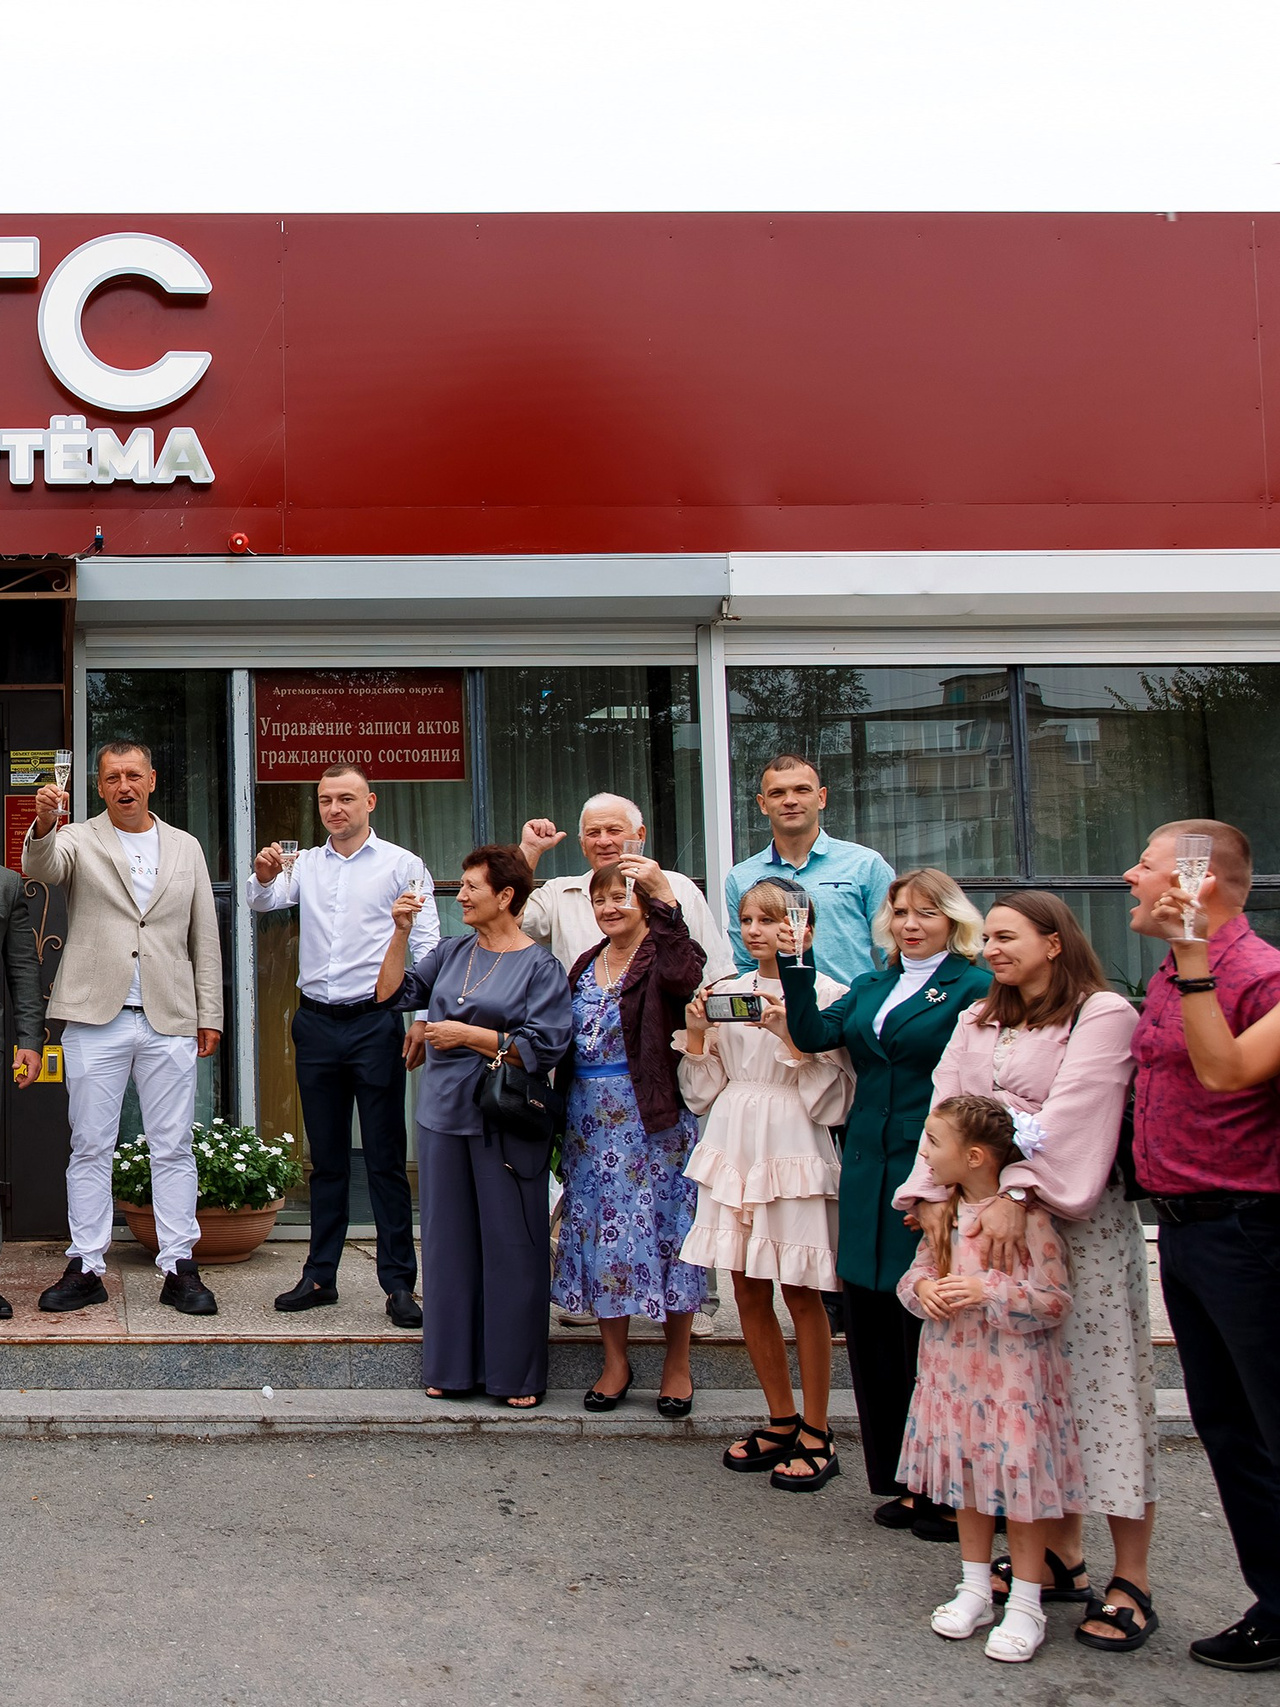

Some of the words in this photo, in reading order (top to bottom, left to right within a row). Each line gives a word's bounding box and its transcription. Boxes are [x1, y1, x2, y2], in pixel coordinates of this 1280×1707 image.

[273, 687, 345, 696] Артемовского
[348, 687, 406, 696] городского
[409, 686, 445, 696] округа
[260, 717, 353, 741] Управление
[358, 720, 412, 736] записи
[417, 720, 460, 735] актов
[261, 749, 373, 769] гражданского
[378, 748, 461, 764] состояния
